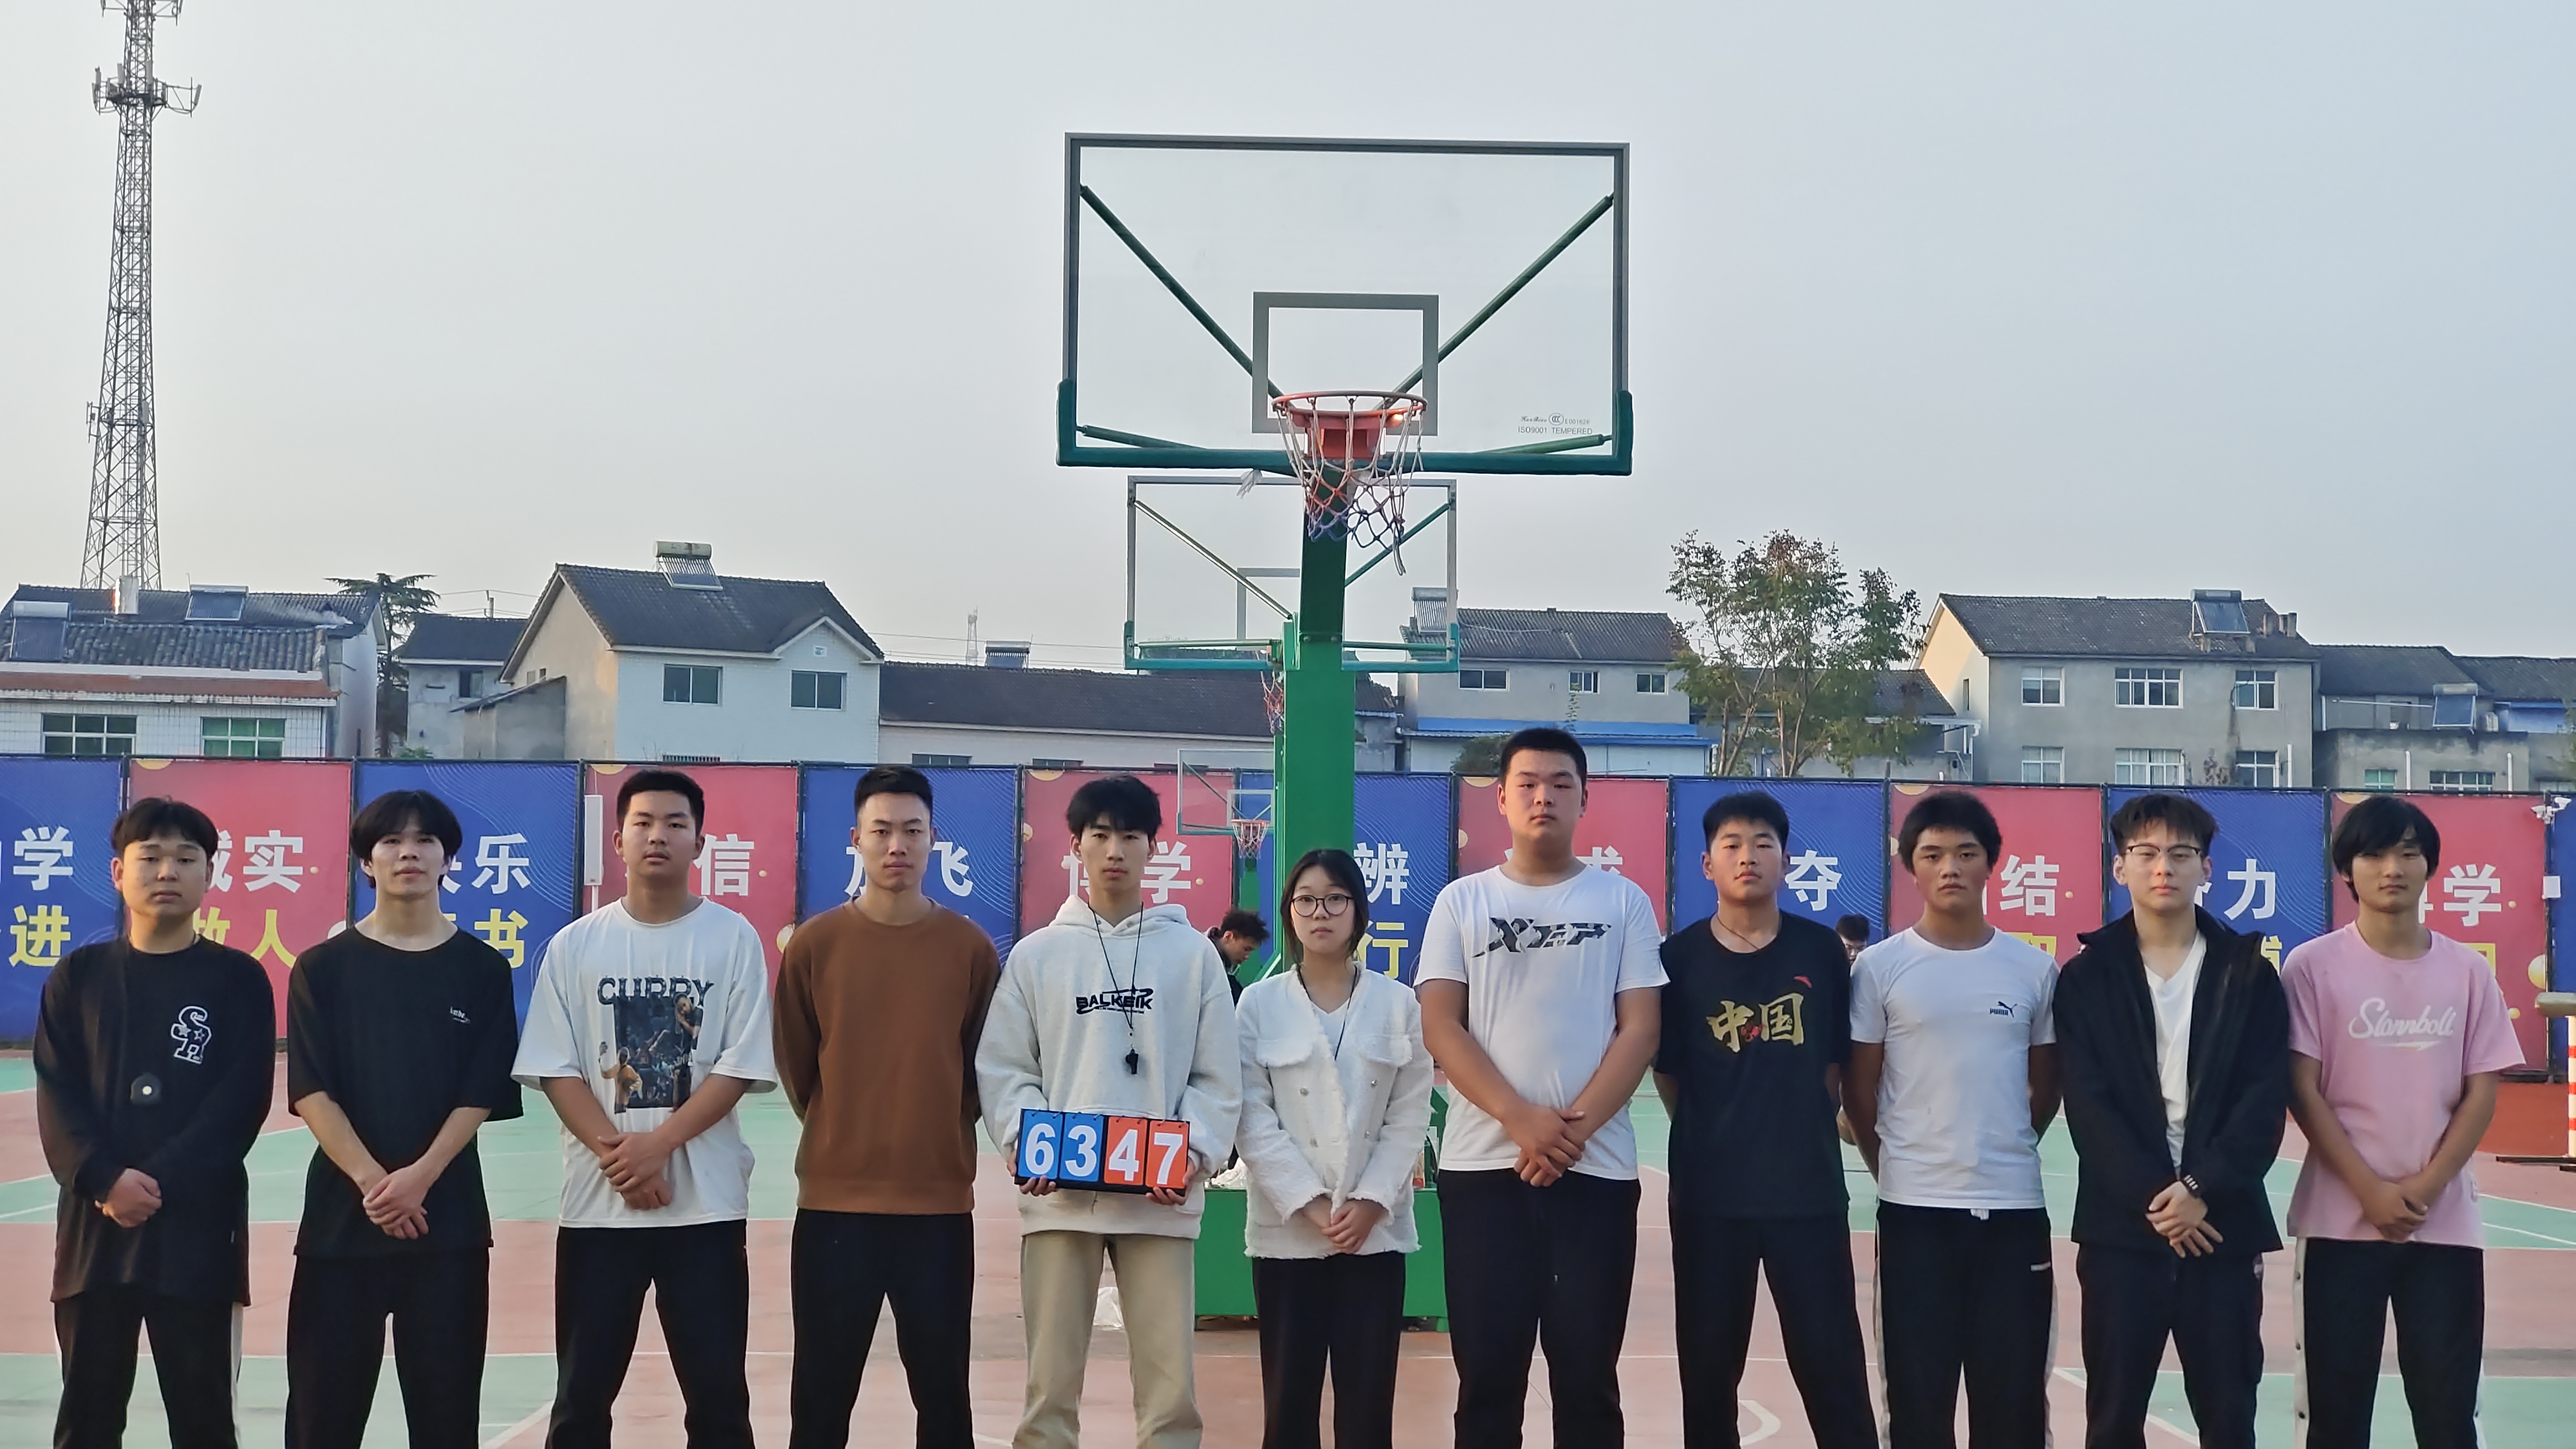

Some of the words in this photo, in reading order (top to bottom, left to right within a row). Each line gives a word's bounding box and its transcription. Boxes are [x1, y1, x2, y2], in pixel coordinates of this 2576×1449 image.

[1551, 427, 1593, 435] TEMPERED
[1982, 855, 2060, 916] 结
[9, 905, 71, 967] 进
[1707, 993, 1804, 1052] 中国
